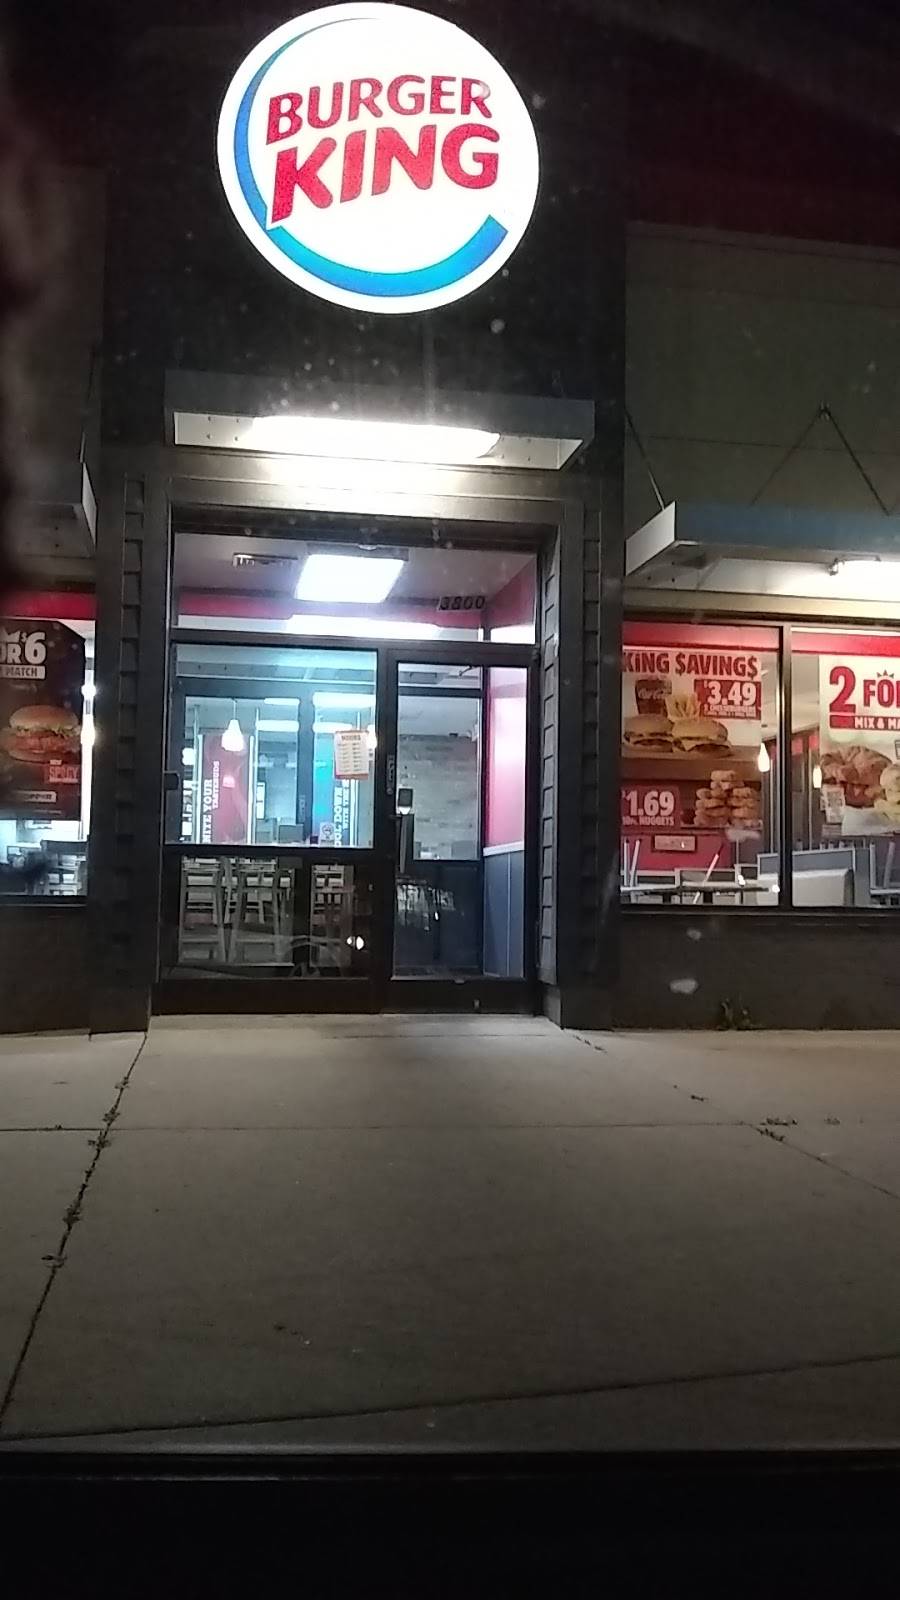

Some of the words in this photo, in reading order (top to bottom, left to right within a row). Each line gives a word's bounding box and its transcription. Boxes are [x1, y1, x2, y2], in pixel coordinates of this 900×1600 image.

[266, 74, 493, 146] BURGER
[271, 122, 500, 224] KING
[440, 596, 486, 611] 3800
[621, 652, 670, 674] KING
[829, 666, 856, 713] 2
[855, 716, 875, 729] MIX
[876, 717, 885, 729] &
[203, 779, 213, 813] YOUR
[334, 787, 343, 823] DOWN
[639, 816, 675, 826] NUGGETS
